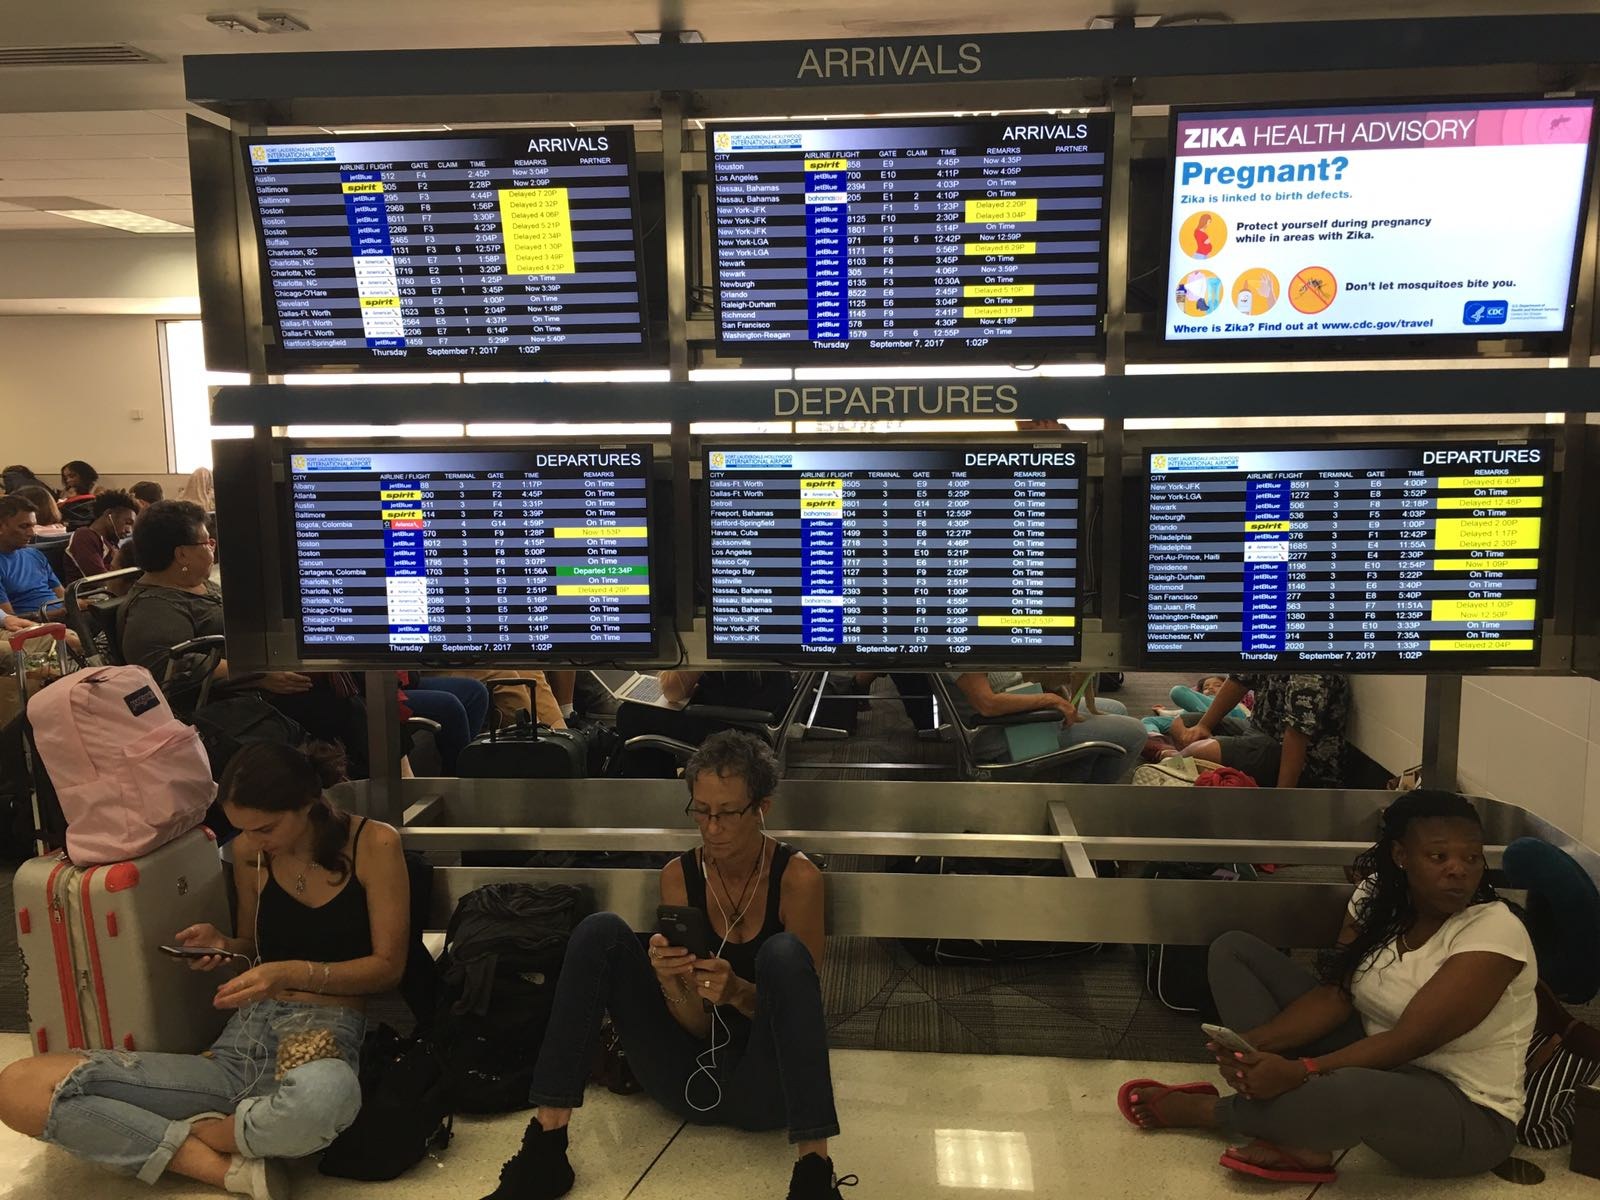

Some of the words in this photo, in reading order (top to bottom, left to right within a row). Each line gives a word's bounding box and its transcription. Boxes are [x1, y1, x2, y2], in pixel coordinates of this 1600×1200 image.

[797, 43, 981, 78] ARRIVALS
[1002, 124, 1087, 140] ARRIVALS
[1184, 127, 1246, 148] ZIKA
[1254, 124, 1345, 146] HEALTH
[1352, 119, 1475, 142] ADVISORY
[528, 137, 608, 152] ARRIVALS
[1181, 157, 1348, 188] Pregnant?
[1209, 194, 1217, 203] is
[1222, 193, 1256, 202] linked
[1276, 192, 1302, 200] birth
[1307, 191, 1352, 199] defects.
[1237, 222, 1278, 231] Protect
[1281, 220, 1328, 231] yourself
[1331, 219, 1368, 230] during
[1372, 217, 1432, 228] pregnancy
[1236, 234, 1265, 243] while
[1319, 231, 1342, 240] with
[1347, 231, 1374, 239] Zika.
[1345, 282, 1375, 291] Don't
[1379, 281, 1393, 290] let
[1398, 280, 1463, 292] mosquitoes
[1467, 279, 1488, 288] bite
[1492, 280, 1516, 289] you.
[1322, 319, 1433, 331] www.cdc.gov/travel
[813, 341, 849, 349] Thursday
[870, 340, 912, 348] September
[427, 348, 468, 356] September
[774, 385, 1018, 416] DEPARTURES
[536, 453, 641, 467] DEPARTURES
[965, 453, 1075, 466] DEPARTURES
[1423, 450, 1540, 464] DEPARTURES
[801, 645, 836, 653] Thursday
